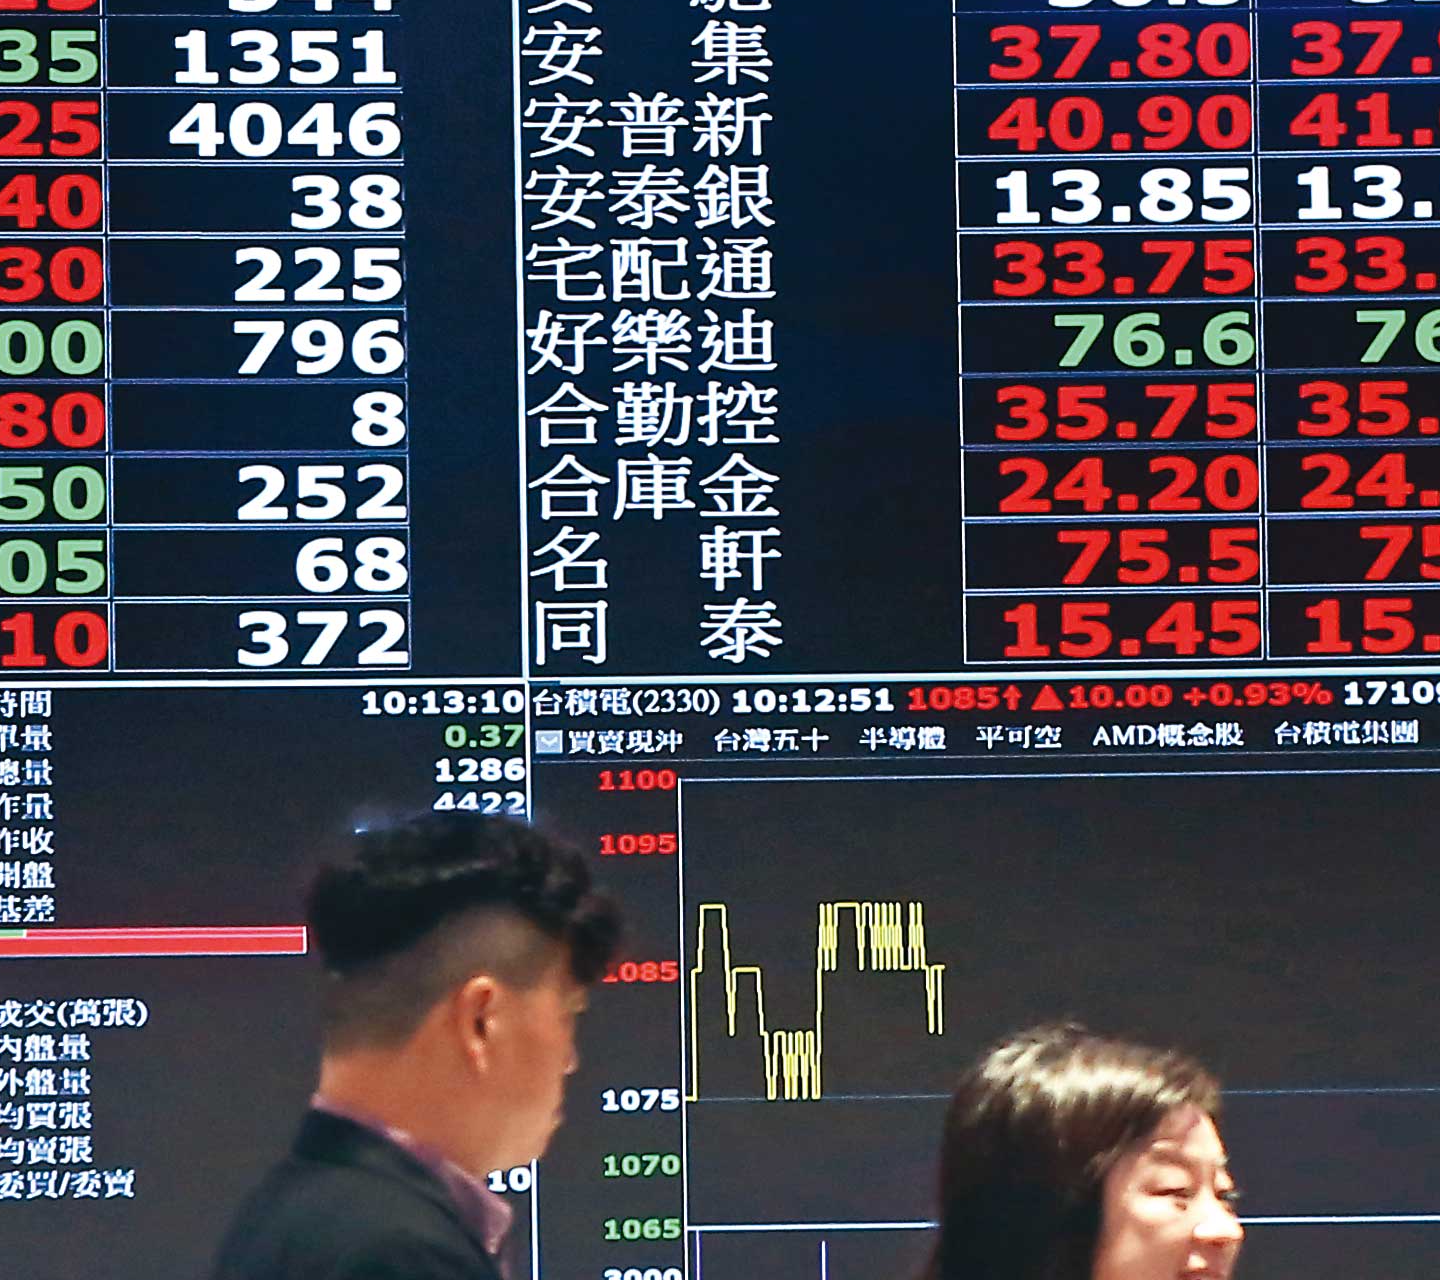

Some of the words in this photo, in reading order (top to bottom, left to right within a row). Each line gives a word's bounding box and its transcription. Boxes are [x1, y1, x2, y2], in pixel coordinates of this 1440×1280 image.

[176, 30, 395, 84] 1351
[170, 103, 400, 156] 4046
[523, 92, 772, 157] 安普新
[989, 95, 1252, 151] 40.90
[526, 237, 776, 301] 宅配通
[994, 240, 1254, 296] 33.75
[526, 308, 777, 375] 好樂迪
[1055, 311, 1254, 367] 76.6
[239, 465, 406, 519] 252
[529, 453, 779, 520] 合庫金
[1000, 455, 1259, 512] 24.20
[239, 611, 407, 665] 372
[363, 690, 524, 714] 10:13:10
[532, 688, 720, 717] 台積電(2330)
[733, 688, 894, 712] 10:12:51
[908, 687, 999, 710] 1085
[1070, 685, 1172, 708] 10.00
[1183, 682, 1333, 706] +0.93%
[445, 725, 524, 747] 0.37
[715, 728, 829, 752] 台灣五十
[860, 727, 946, 750] 半導體
[436, 758, 525, 782] 1286
[599, 770, 676, 790] 1100
[603, 1089, 679, 1111] 1075
